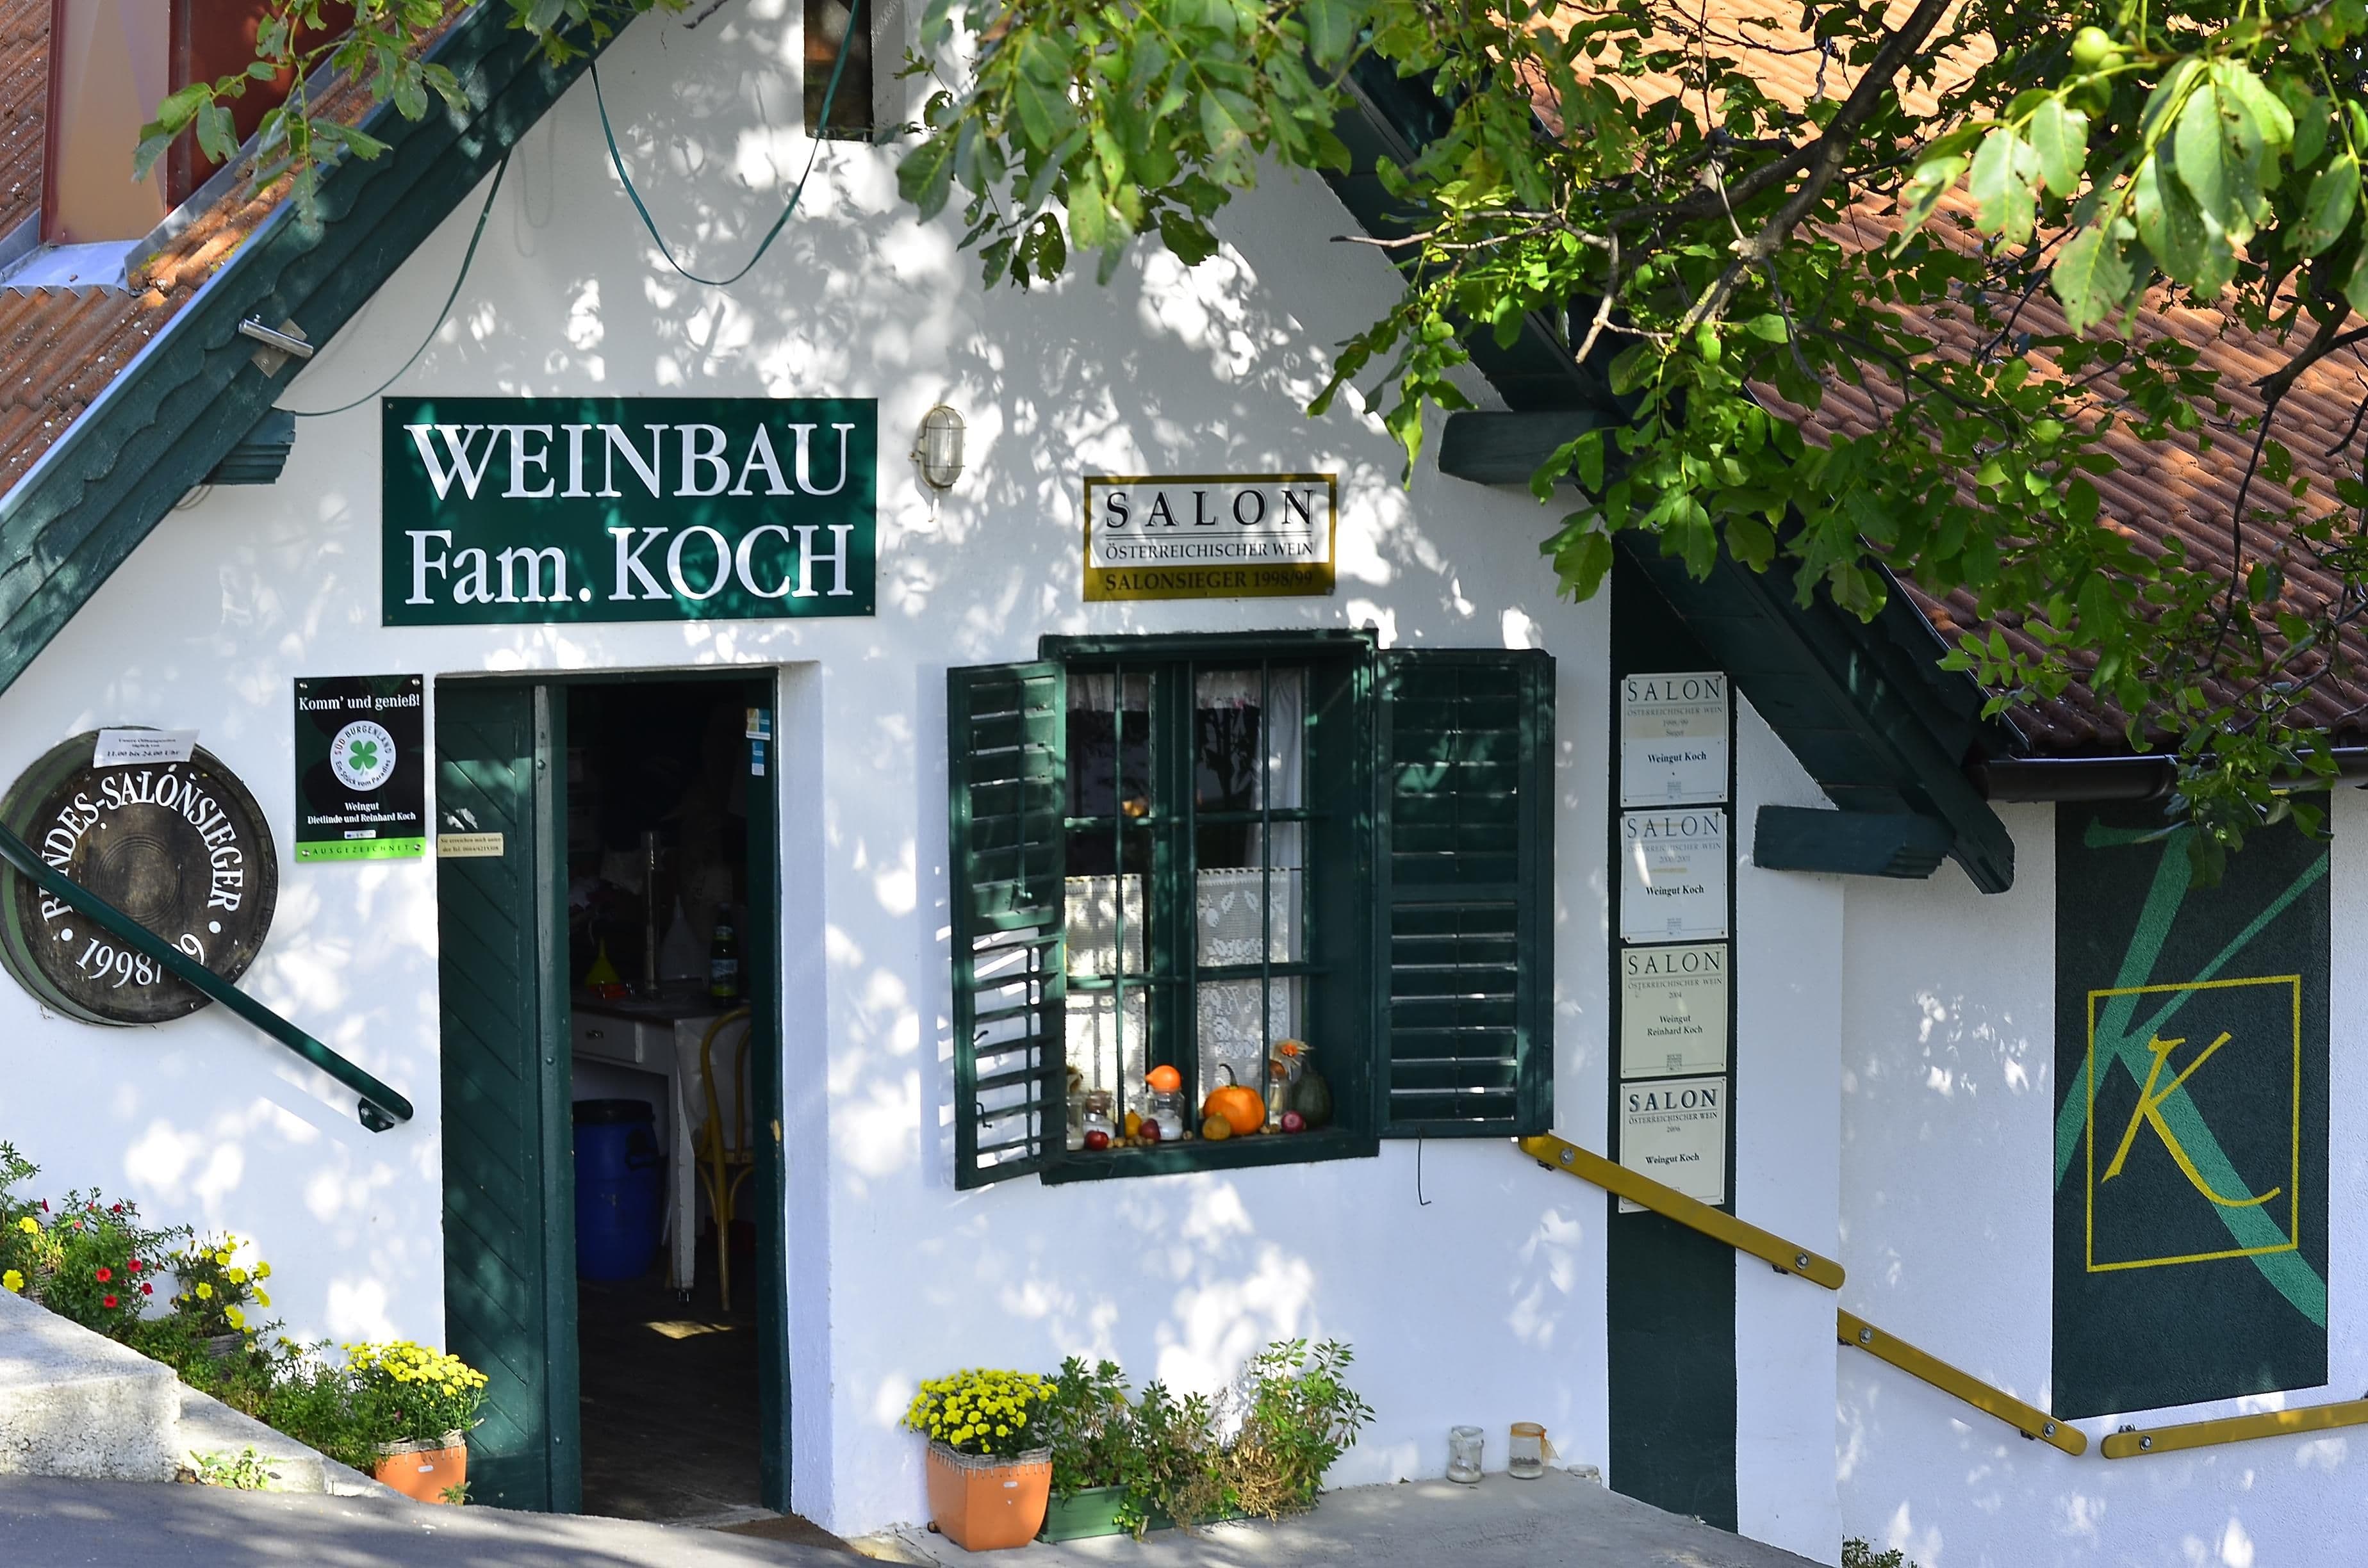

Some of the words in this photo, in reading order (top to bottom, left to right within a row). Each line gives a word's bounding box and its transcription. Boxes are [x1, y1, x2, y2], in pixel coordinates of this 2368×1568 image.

[403, 422, 855, 501] WEINBAU
[1106, 489, 1315, 528] SALON
[1106, 542, 1268, 559] ÖSTERREICHISCHER
[1273, 542, 1313, 555] WEIN
[405, 529, 592, 605] Fam.
[607, 523, 854, 601] KOCH
[1106, 572, 1246, 591] SALONSIEGER
[1254, 571, 1313, 588] 1998/99
[1627, 679, 1720, 702] SALON
[299, 696, 343, 710] Komm'
[347, 695, 371, 708] und
[375, 694, 420, 710] genieß!
[334, 738, 345, 755] SÜD
[345, 725, 392, 754] BURGENLAND
[1647, 754, 1682, 764] Weingut
[1684, 751, 1707, 761] Koch
[344, 802, 379, 812] Weingut
[307, 815, 343, 824] Dietlinde
[343, 814, 359, 823] und
[361, 813, 396, 822] Reinhard
[397, 812, 416, 821] Koch
[1627, 815, 1719, 838] SALON
[39, 771, 244, 923] BNDES-SALONSIEGER
[313, 845, 409, 855] AUSGEZEICHNET
[1627, 844, 1698, 852] ÖSRREICHISCHER
[1646, 886, 1680, 897] Weingut
[1682, 885, 1704, 894] Koch
[76, 933, 206, 988] 1998/9
[1628, 952, 1720, 975] SALON
[1659, 1015, 1691, 1025] Weingut
[1647, 1027, 1681, 1036] Reinhard
[1684, 1025, 1703, 1034] Koch
[1629, 1088, 1718, 1113] SALON
[1629, 1113, 1697, 1124] ÖSTERREICHISCHER
[2101, 1031, 2282, 1207] K
[1645, 1156, 1678, 1164] Weingut
